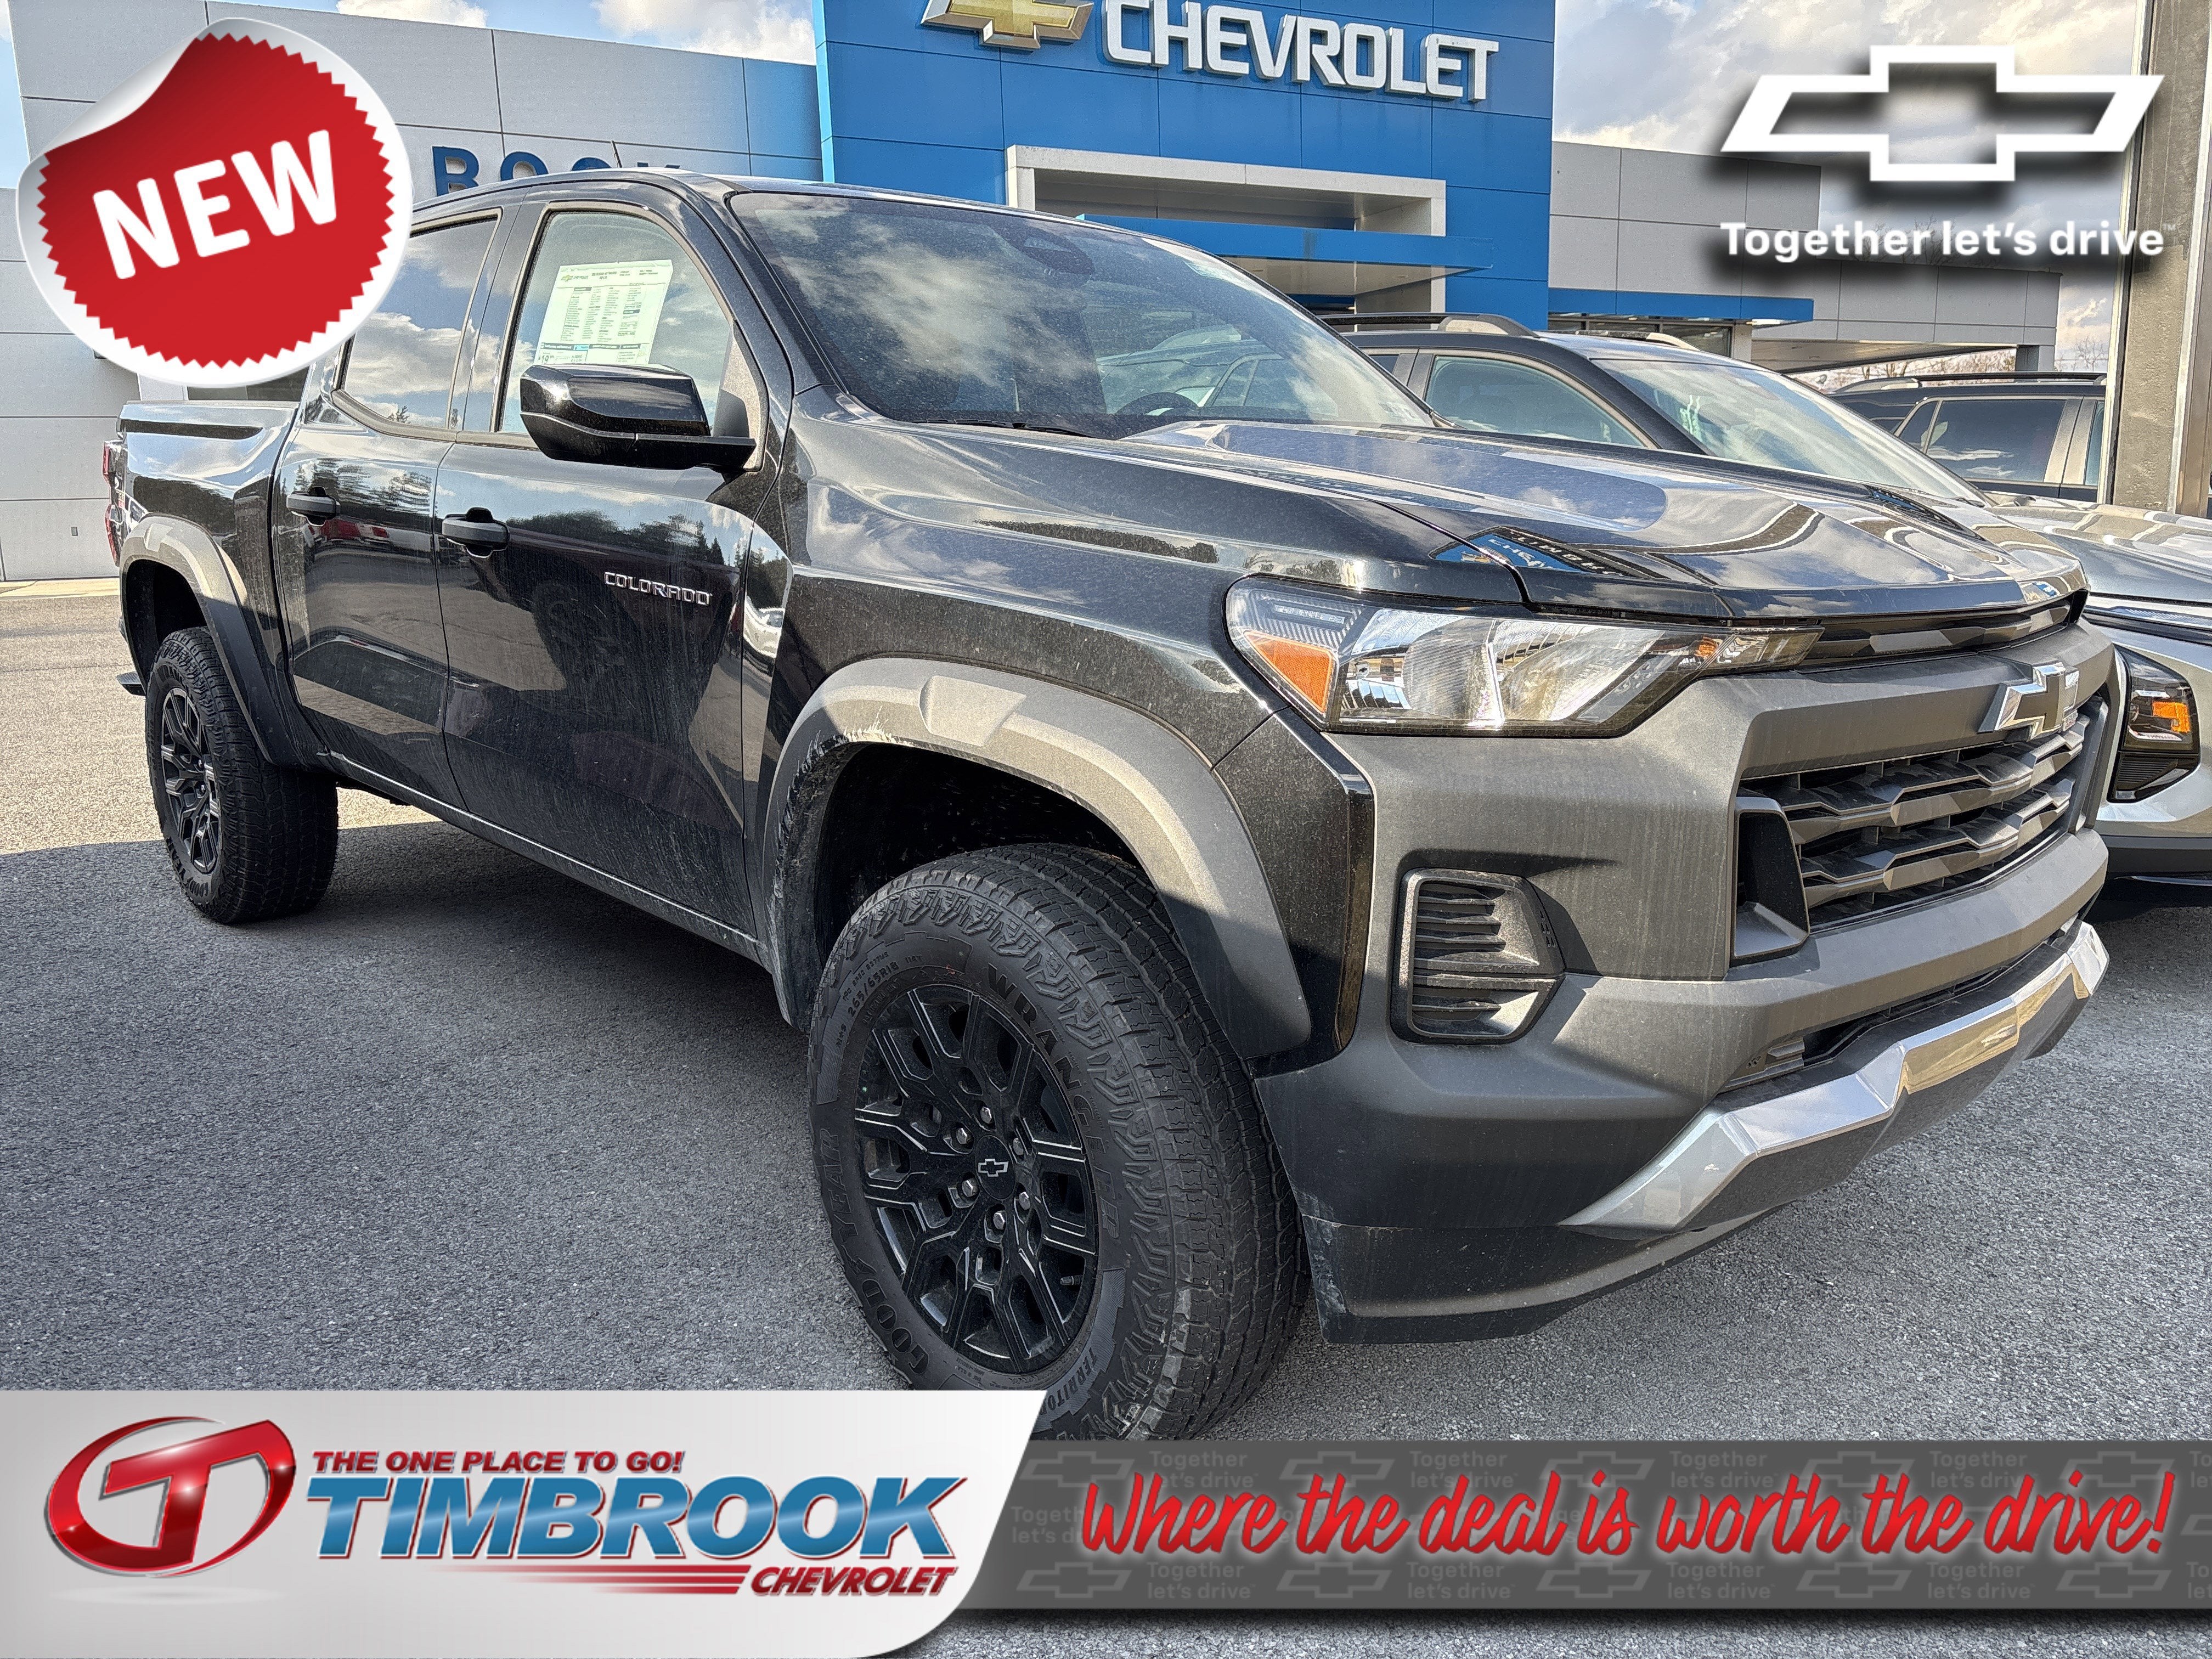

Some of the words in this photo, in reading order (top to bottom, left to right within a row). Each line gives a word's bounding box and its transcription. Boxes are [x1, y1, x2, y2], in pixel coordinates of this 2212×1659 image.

[1104, 0, 1500, 103] CHEVROLET
[603, 572, 713, 606] COLORADO
[848, 961, 899, 1018] 265/65R18
[987, 962, 1120, 1239] WRANGLER
